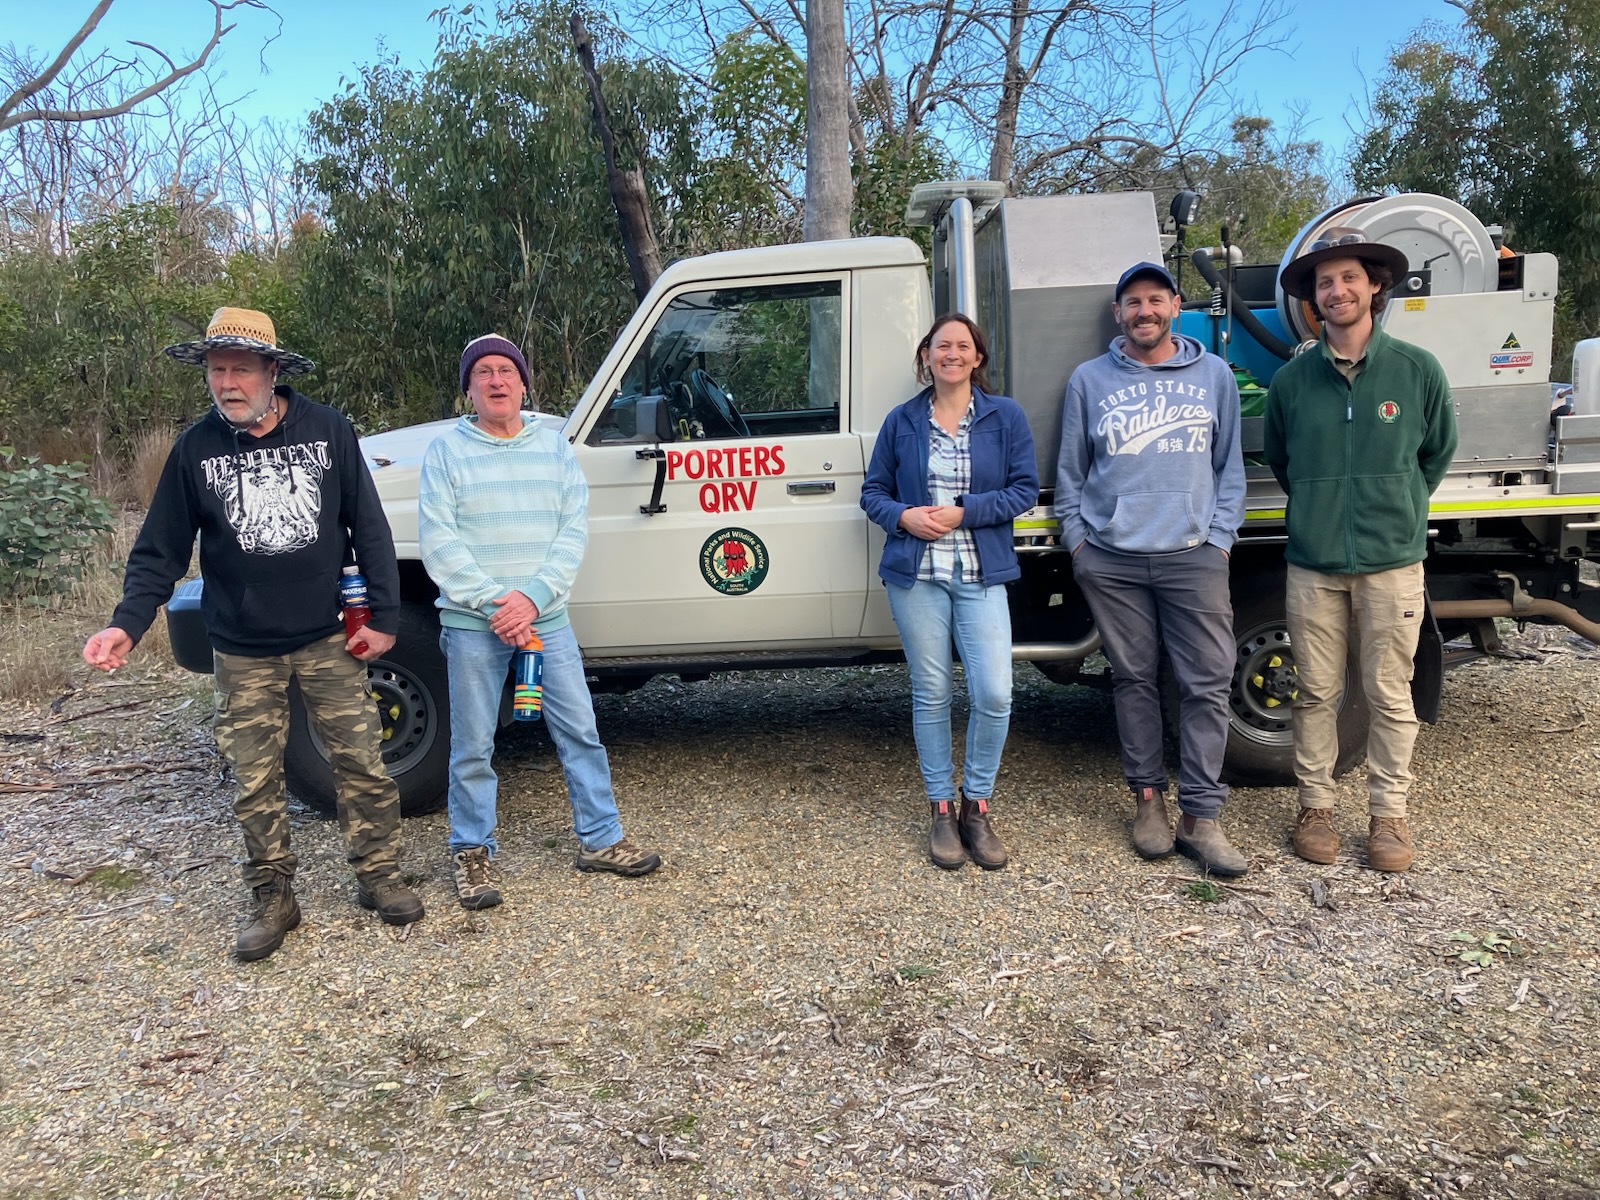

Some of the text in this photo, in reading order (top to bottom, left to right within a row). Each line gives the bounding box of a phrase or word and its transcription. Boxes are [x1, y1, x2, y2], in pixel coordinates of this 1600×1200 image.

[1099, 380, 1207, 411] TOKYO STATE
[1097, 395, 1213, 456] Raiders
[1157, 427, 1208, 453] 勇強 75
[667, 445, 786, 480] PORTERS
[699, 481, 758, 514] QRV
[704, 531, 765, 584] National Parks and Wildlife Service
